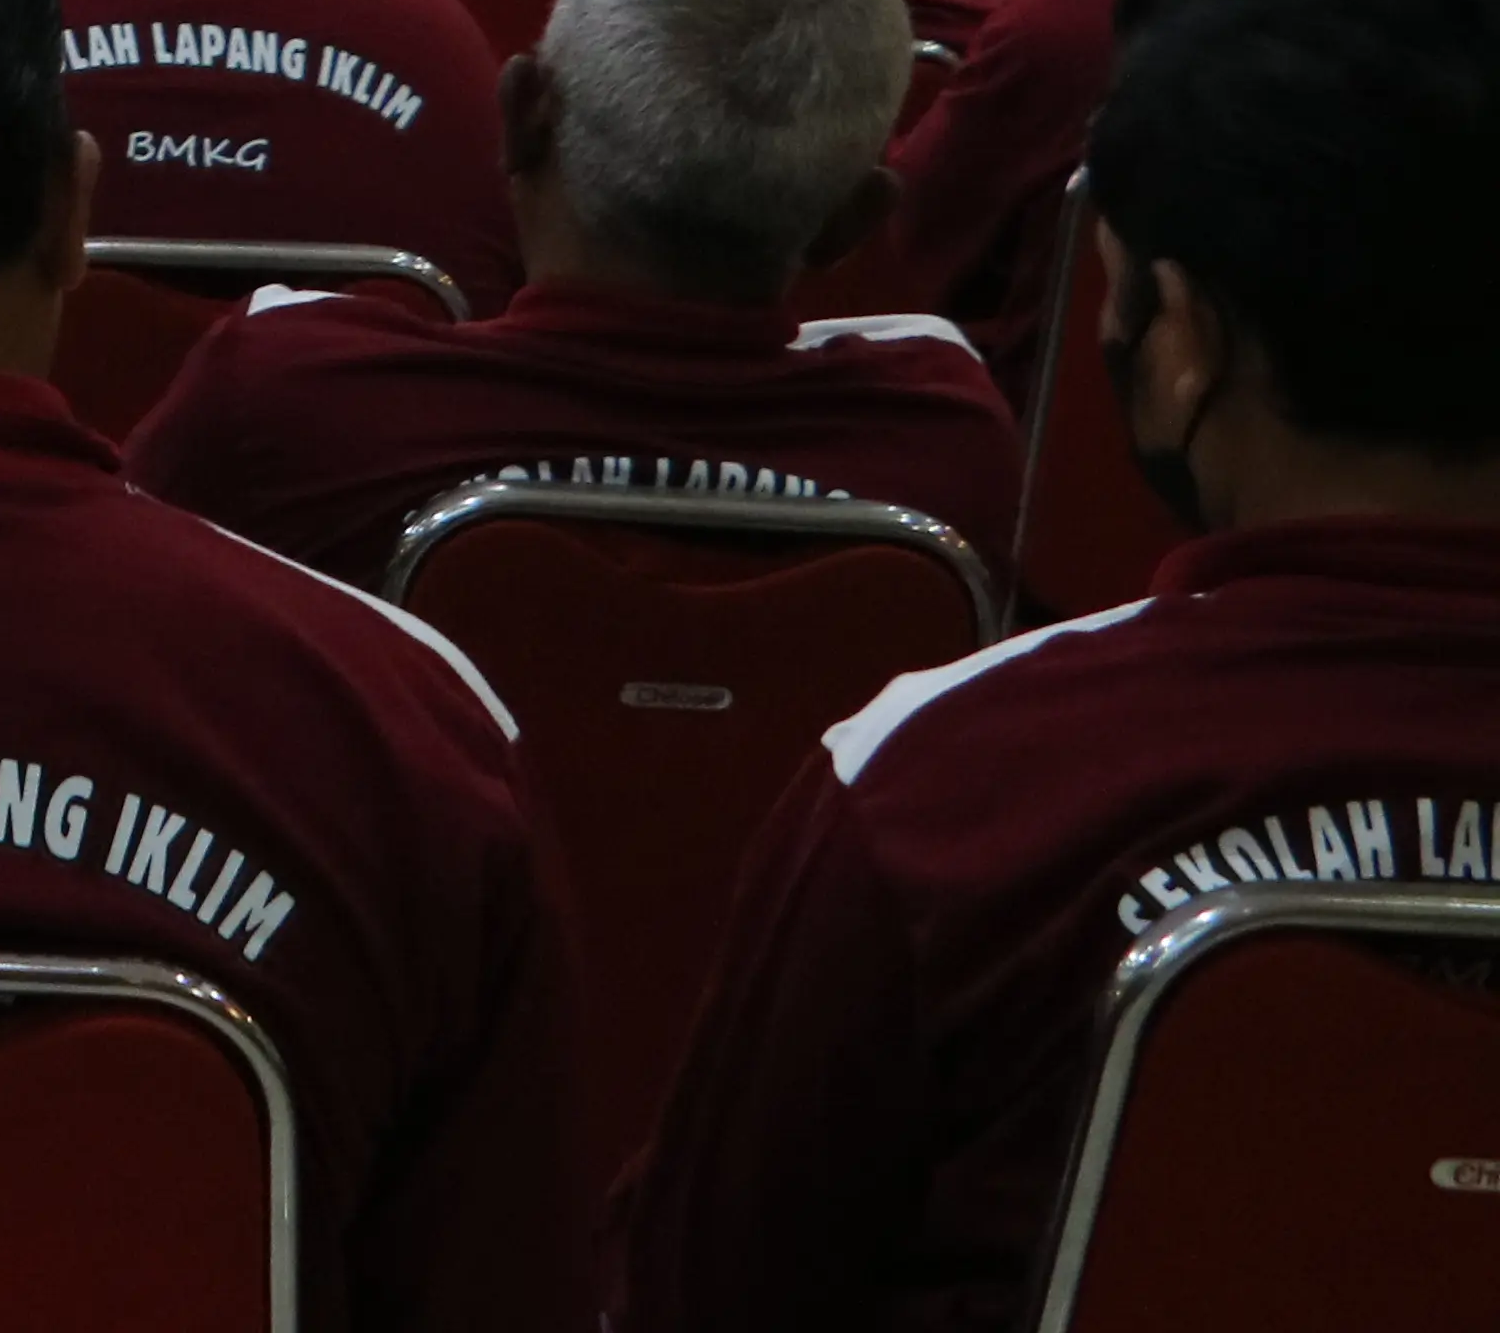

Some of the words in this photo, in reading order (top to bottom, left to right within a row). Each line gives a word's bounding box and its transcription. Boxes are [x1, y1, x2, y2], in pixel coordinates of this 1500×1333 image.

[152, 21, 307, 80] LAPANG
[317, 45, 422, 130] IKLIM
[126, 130, 269, 171] BMKG
[105, 793, 294, 961] IKLIM
